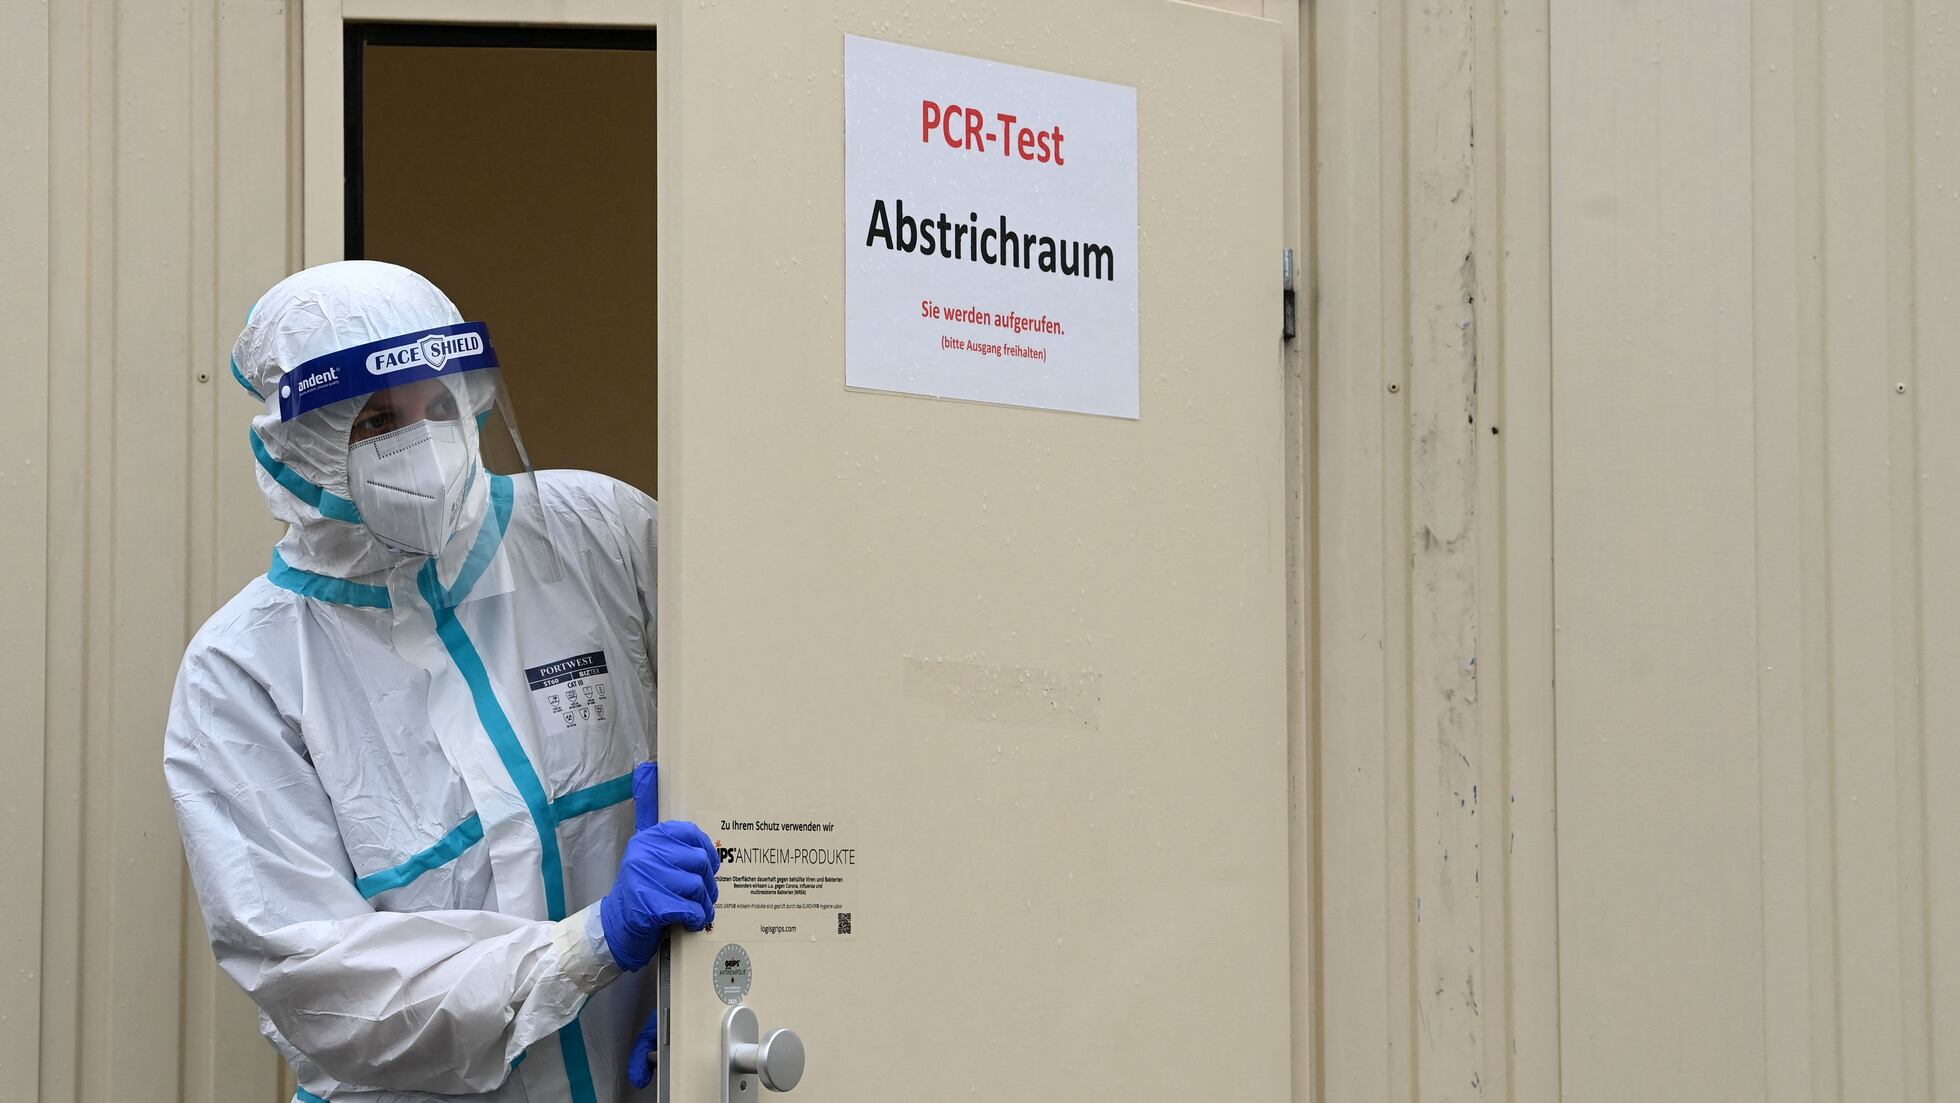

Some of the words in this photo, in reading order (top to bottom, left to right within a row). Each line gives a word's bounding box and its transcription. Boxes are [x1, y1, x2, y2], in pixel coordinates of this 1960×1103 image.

[922, 100, 1064, 166] PCR-Test
[866, 199, 1114, 281] Abstrichraum
[921, 300, 940, 319] Sie
[943, 306, 991, 326] werden
[994, 311, 1065, 335] aufgerufen.
[374, 346, 421, 371] FACE
[430, 335, 479, 358] SHIELD
[941, 335, 965, 350] (bitte
[967, 339, 1002, 357] Ausgang
[1003, 343, 1047, 363] freihalten)
[540, 656, 593, 677] PORTWEST
[567, 680, 578, 689] CAT
[720, 820, 731, 830] Zu
[732, 820, 754, 831] Ihrem
[755, 820, 780, 832] Schutz
[781, 821, 821, 832] verwenden
[822, 822, 835, 832] wir
[734, 847, 856, 865] ANTIKEIM-PRODUKTE
[760, 924, 797, 934] logisgrips.com
